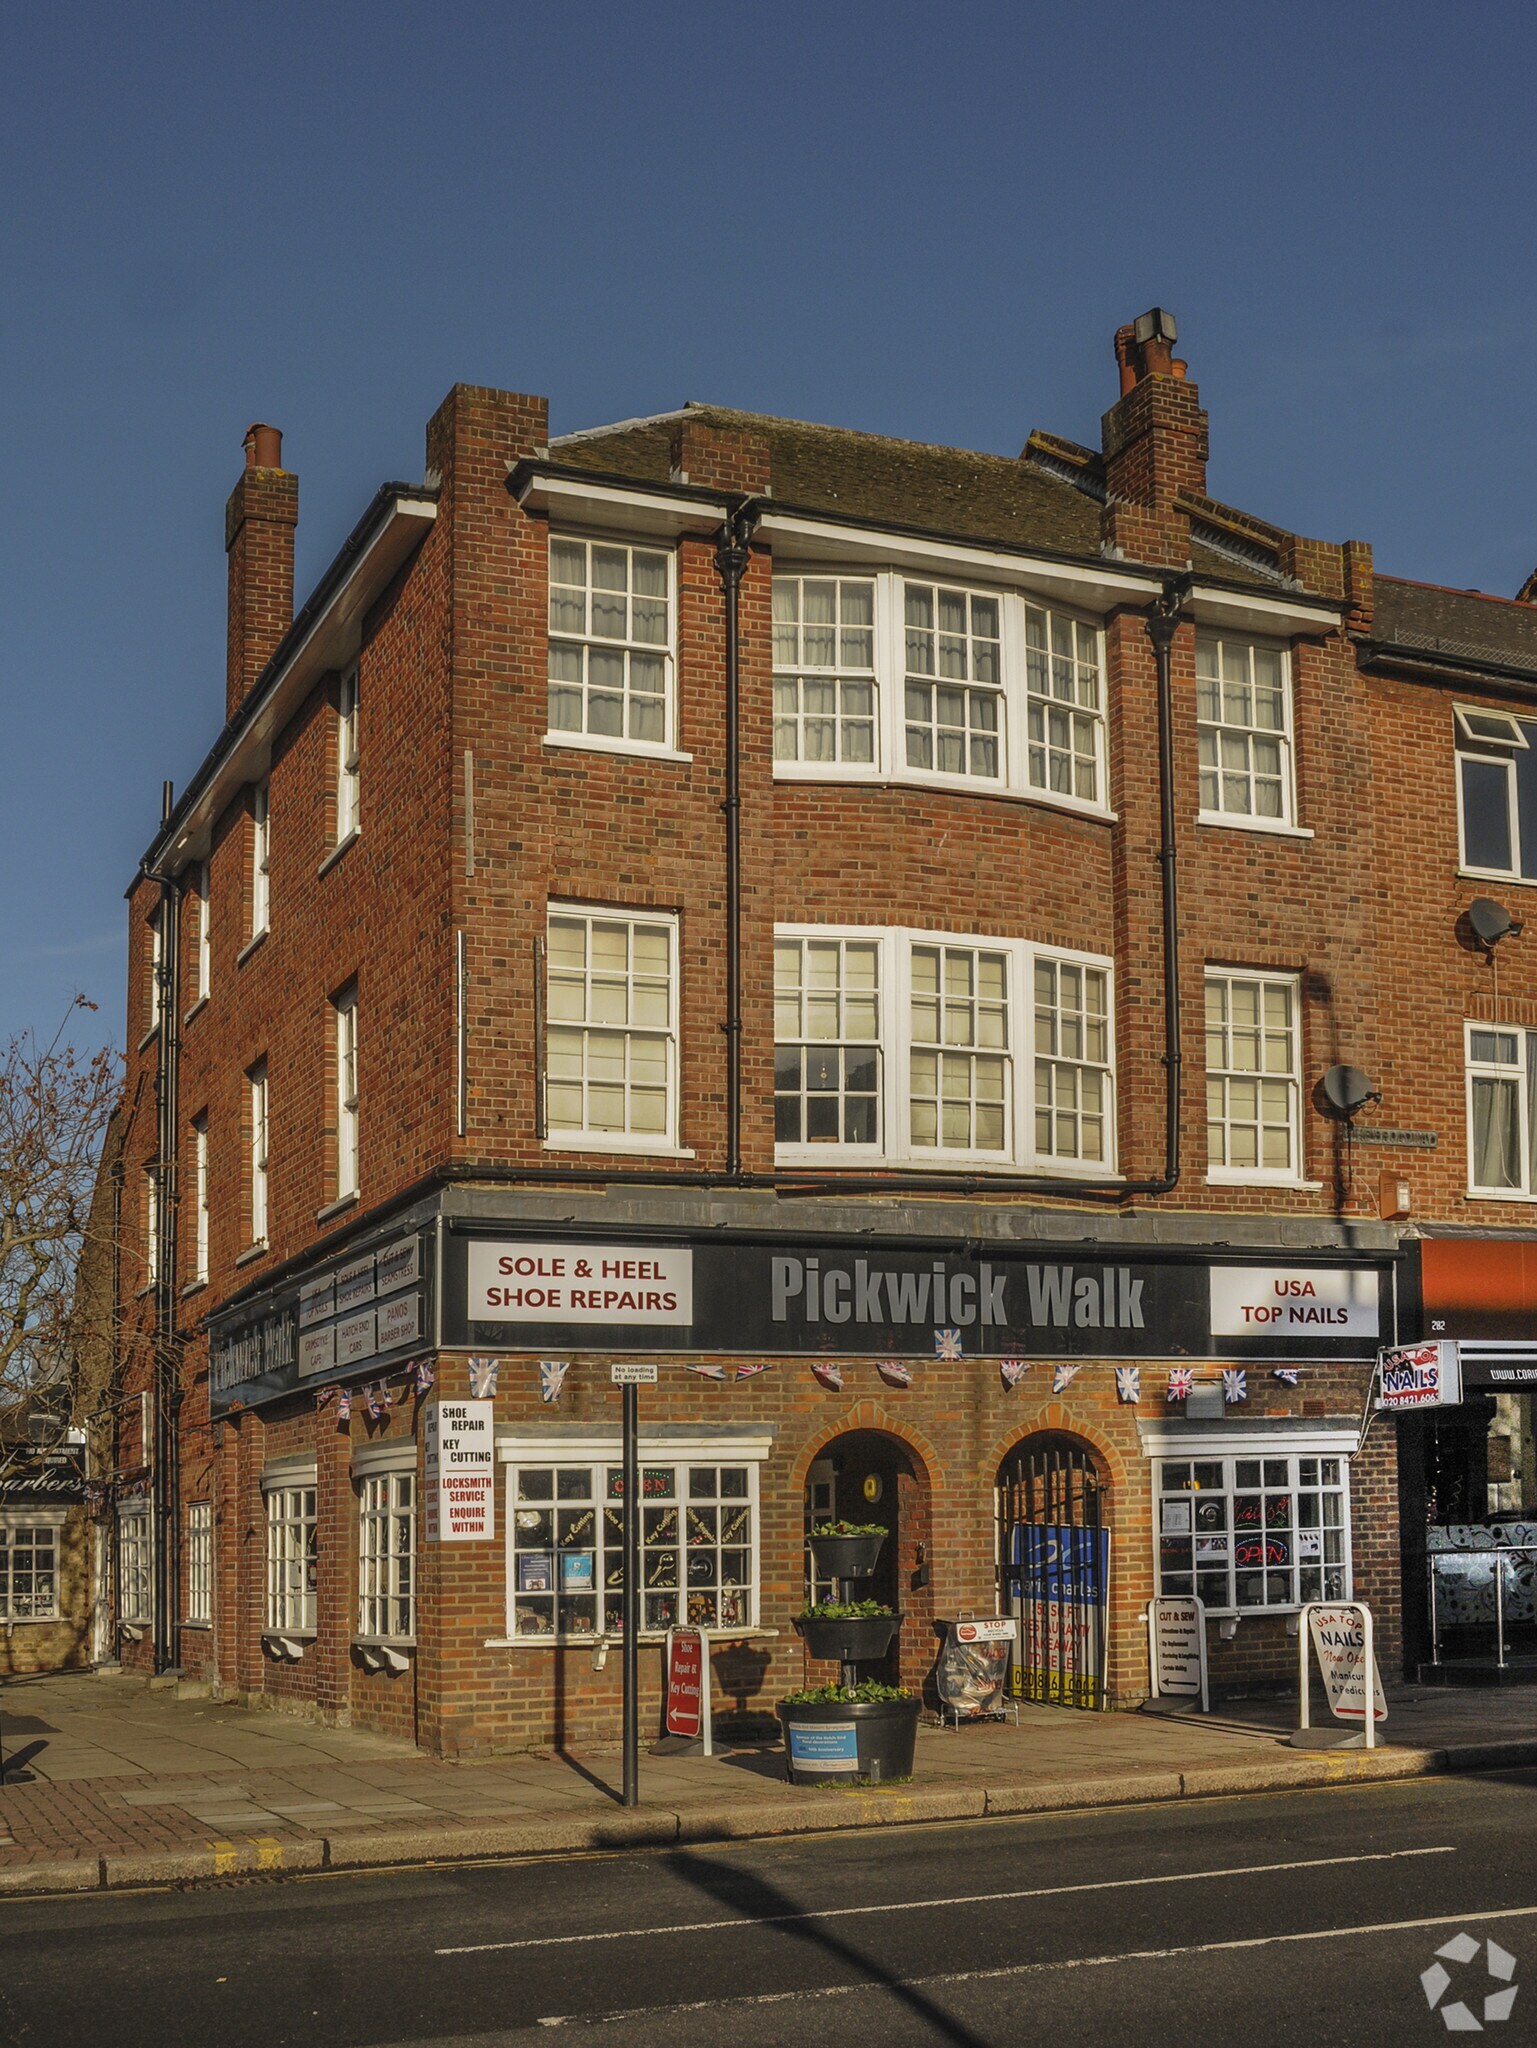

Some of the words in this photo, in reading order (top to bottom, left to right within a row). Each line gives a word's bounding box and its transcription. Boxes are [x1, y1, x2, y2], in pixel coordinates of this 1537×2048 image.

[382, 1263, 413, 1286] SEAMSTRESS
[498, 1257, 566, 1277] SOLE
[574, 1259, 593, 1278] &
[602, 1260, 667, 1280] HEEL
[771, 1256, 1008, 1326] Pickwick
[1026, 1264, 1145, 1328] Walk
[1274, 1280, 1316, 1297] USA
[486, 1287, 561, 1308] SHOE
[570, 1290, 678, 1311] REPAIRS
[387, 1302, 408, 1323] PANOS
[1241, 1306, 1283, 1323] TOP
[1290, 1307, 1348, 1324] NAILS
[359, 1320, 370, 1333] END
[381, 1327, 400, 1344] BARBER
[401, 1321, 415, 1338] SHOP
[1431, 1320, 1446, 1331] 282
[349, 1341, 362, 1354] CARS
[1384, 1351, 1410, 1371] USA
[1385, 1368, 1438, 1392] NAILS
[1384, 1398, 1398, 1407] 020
[442, 1407, 467, 1418] SHOE
[451, 1420, 485, 1431] REPAIR
[442, 1439, 460, 1450] KEY
[450, 1452, 491, 1462] CUTTING
[442, 1478, 492, 1489] LOCKSMITH
[613, 1478, 667, 1492] OEN
[449, 1491, 485, 1502] SERVICE
[449, 1507, 486, 1519] ENQUIRE
[451, 1522, 485, 1533] WITHIN
[560, 1533, 574, 1548] Key
[572, 1510, 594, 1535] Cutting
[645, 1531, 659, 1545] Key
[657, 1509, 678, 1533] Cutting
[721, 1530, 734, 1544] Key
[1235, 1546, 1283, 1564] OPEN
[1159, 1612, 1171, 1621] CUT
[1173, 1612, 1179, 1621] &
[1180, 1612, 1195, 1621] SEW
[1315, 1615, 1337, 1628] USA
[1340, 1616, 1363, 1629] TOP
[984, 1621, 1006, 1629] STOP
[1320, 1631, 1364, 1647] NAILS
[681, 1641, 693, 1653] Shoe
[1324, 1650, 1344, 1662] Now
[1347, 1652, 1365, 1666] Ope
[674, 1661, 691, 1675] Repair
[692, 1664, 697, 1674] &
[670, 1681, 680, 1695] Key
[681, 1682, 700, 1697] Cutting
[1332, 1685, 1338, 1694] &
